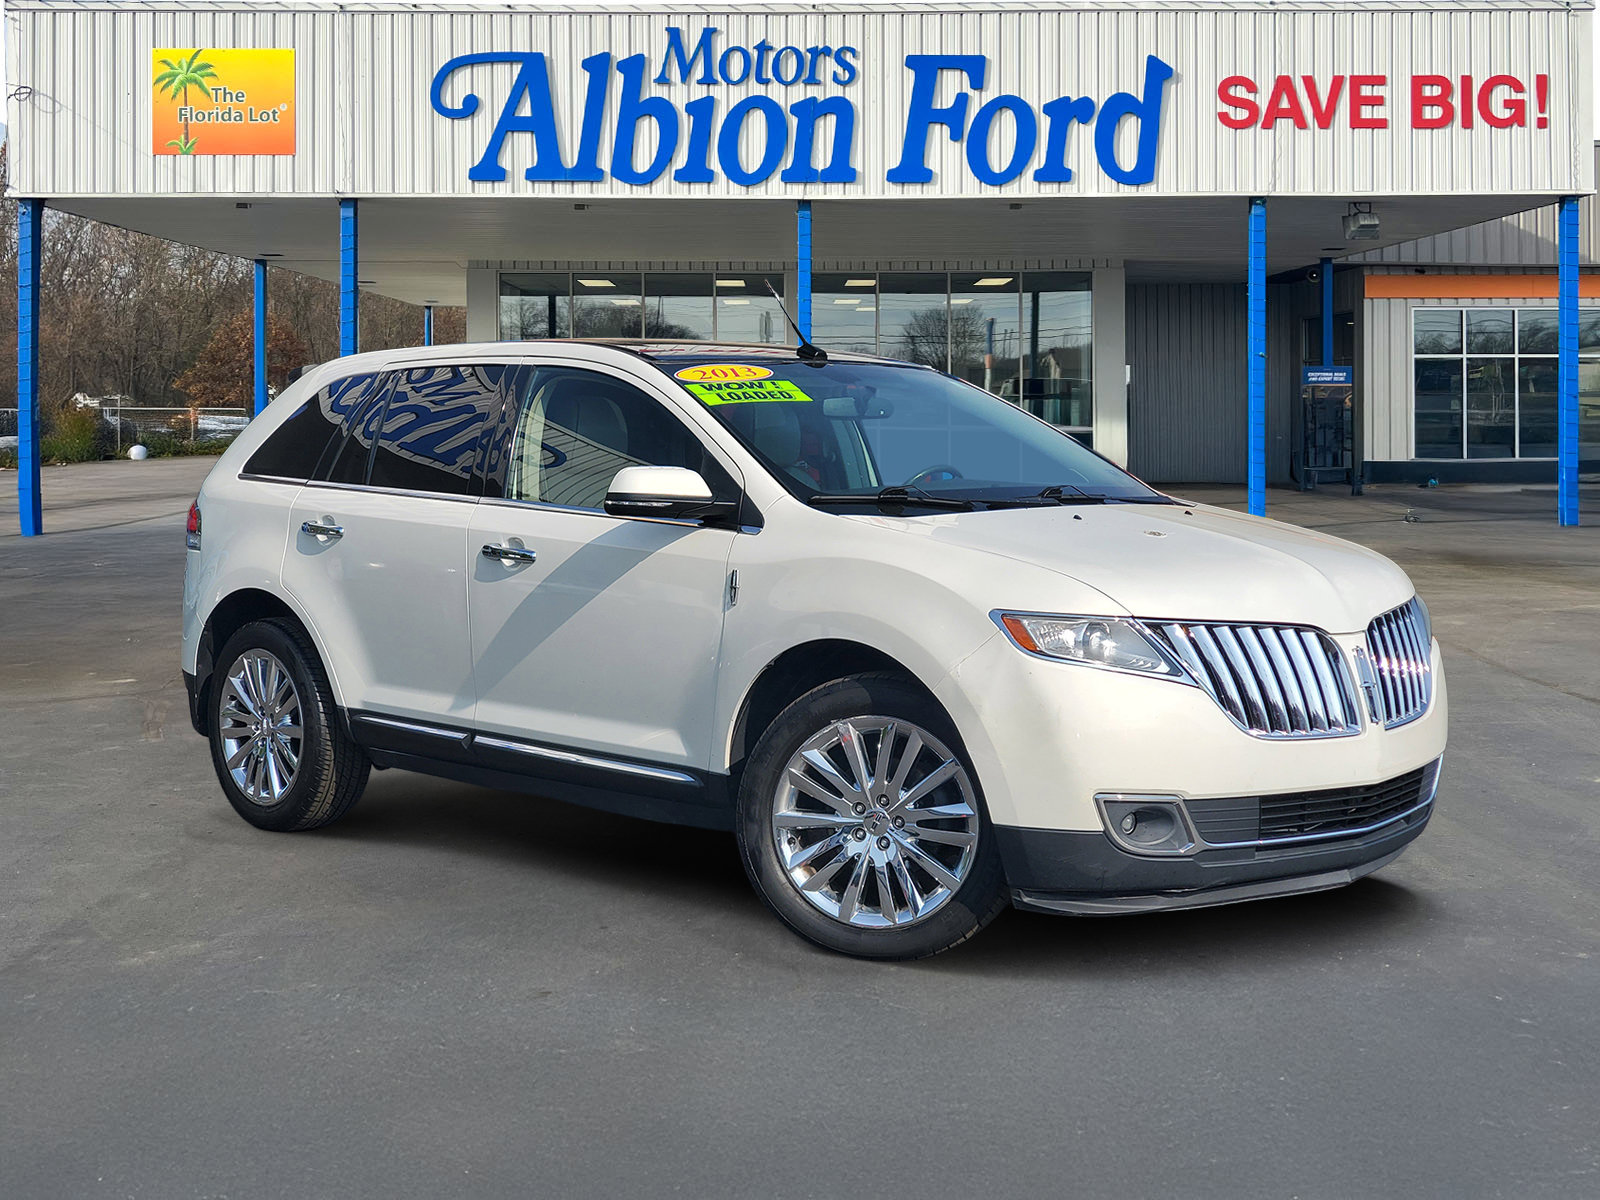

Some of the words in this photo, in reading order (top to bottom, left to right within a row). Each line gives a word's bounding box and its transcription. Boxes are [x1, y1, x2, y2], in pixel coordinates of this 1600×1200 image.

[653, 27, 857, 85] Motors
[211, 87, 245, 103] The
[1217, 75, 1388, 129] SAVE
[1411, 74, 1548, 129] BIG!
[178, 107, 243, 122] Florida
[249, 107, 279, 122] Lot
[430, 51, 857, 186] Albion
[886, 54, 1174, 186] Ford
[693, 367, 757, 380] 2013
[716, 391, 794, 402] LOADED
